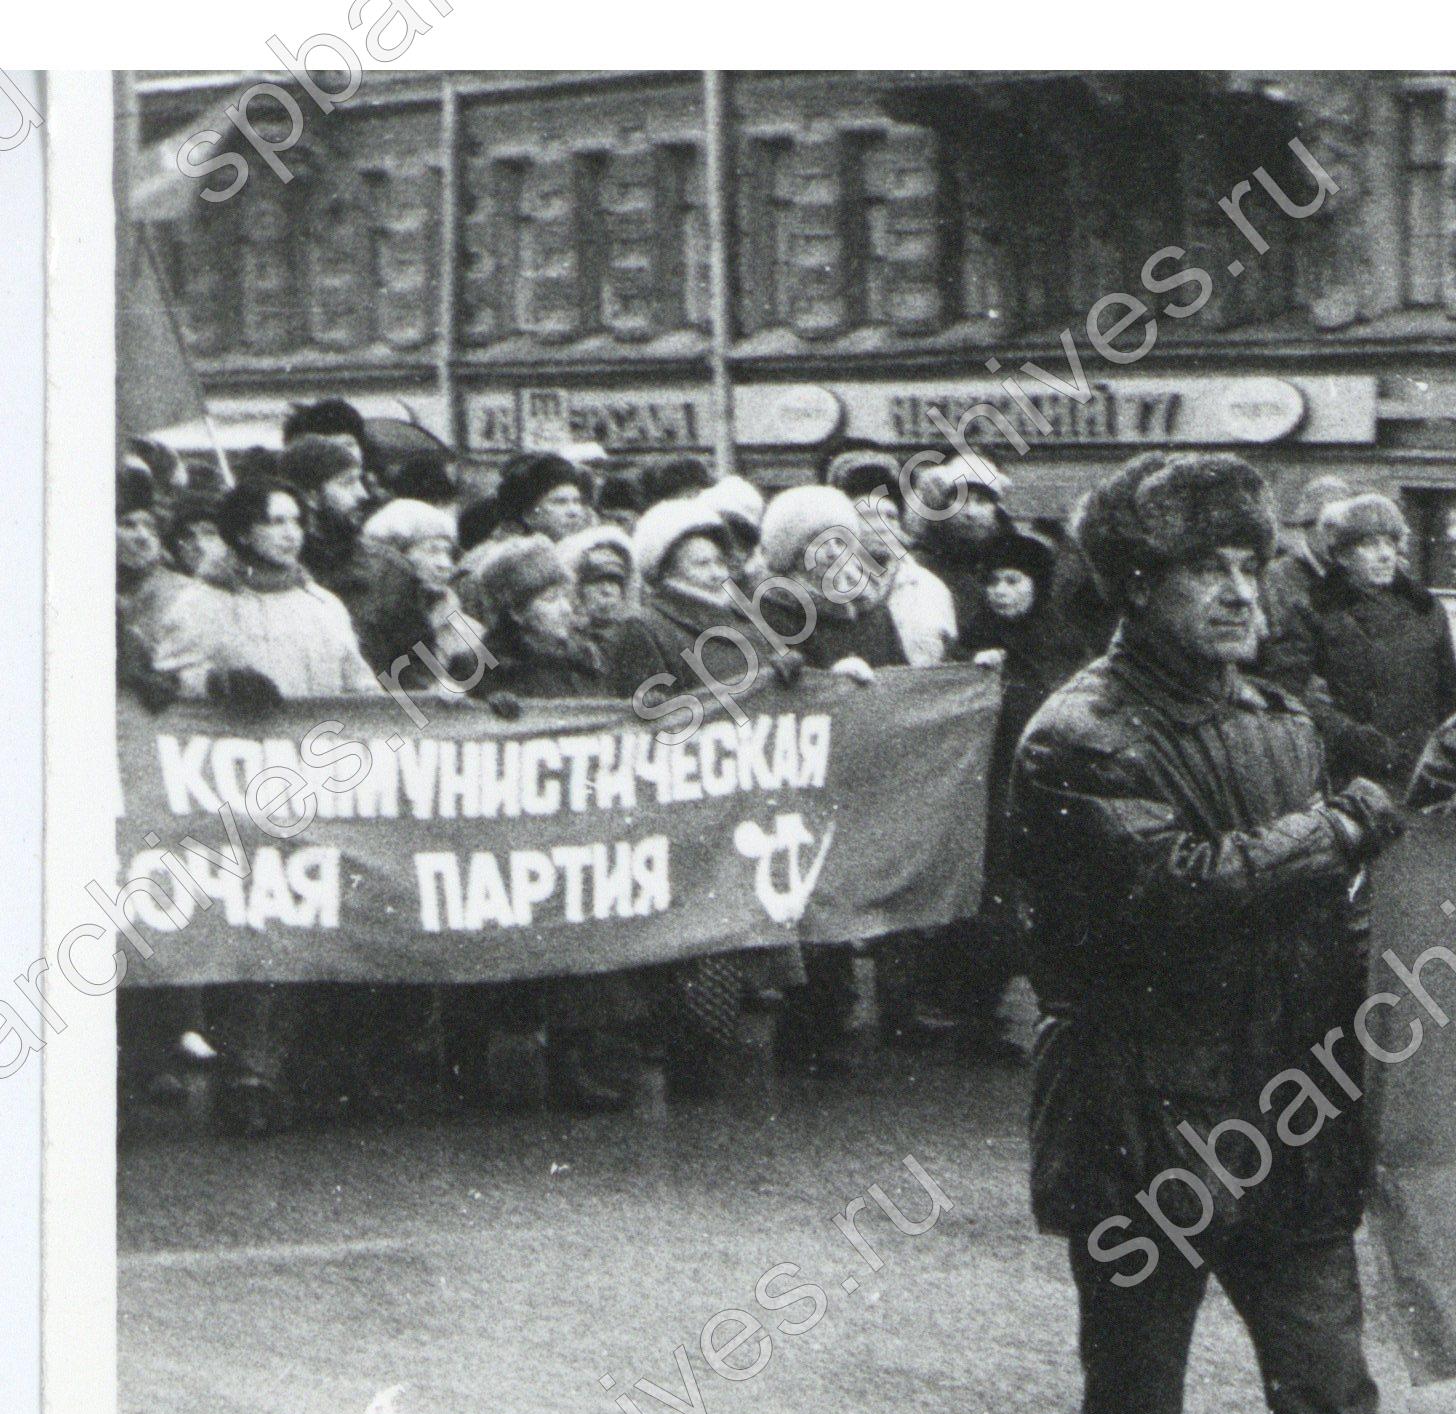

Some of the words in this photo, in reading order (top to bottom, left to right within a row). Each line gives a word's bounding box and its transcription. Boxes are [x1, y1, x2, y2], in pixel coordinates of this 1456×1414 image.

[156, 713, 832, 819] КОММУНИСТИЧЕСКАЯ
[116, 846, 341, 932] ОЧАЯ
[415, 837, 670, 931] ПАРТИЯ
